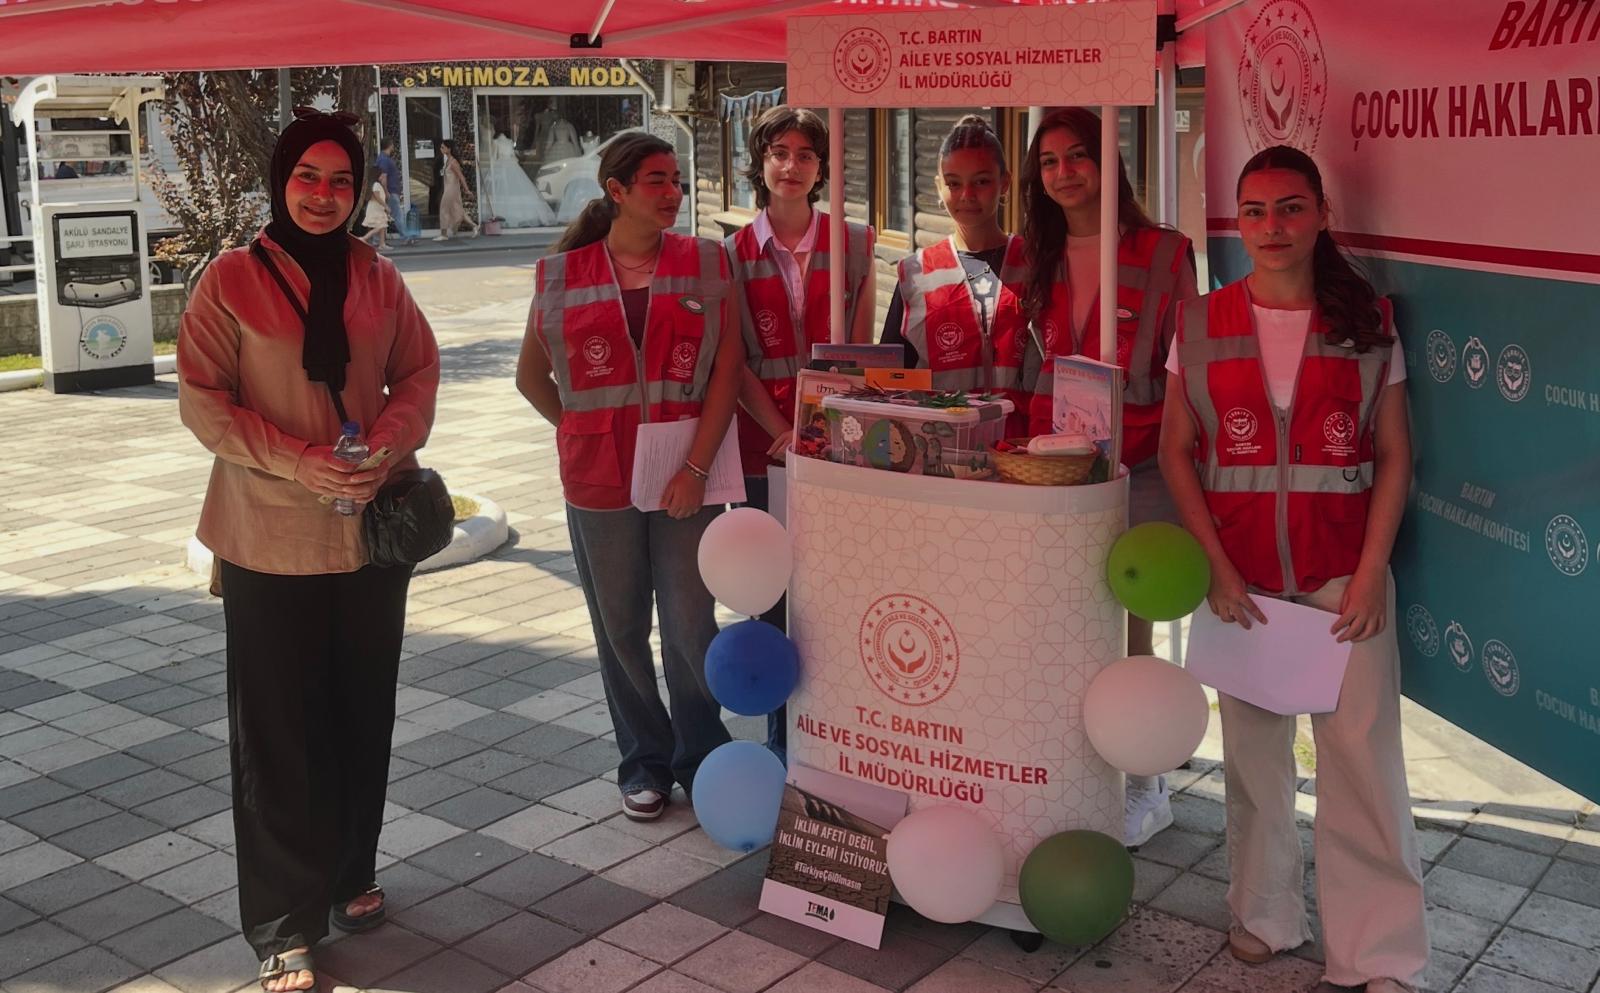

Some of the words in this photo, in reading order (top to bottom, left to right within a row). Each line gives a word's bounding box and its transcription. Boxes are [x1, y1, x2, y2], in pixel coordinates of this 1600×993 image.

[899, 31, 925, 45] T.C.
[928, 29, 982, 44] BARTIN
[899, 50, 933, 67] AİLE
[935, 52, 953, 66] VE
[956, 50, 1012, 66] SOSYAL
[1015, 48, 1102, 65] HİZMETLER
[899, 72, 913, 89] İL
[915, 71, 1012, 89] MÜDÜRLÜĞÜ
[1351, 86, 1440, 152] ÇOCUK
[63, 226, 89, 237] AKÜLÜ
[91, 226, 129, 236] SANDALYE
[1545, 384, 1587, 411] ÇOCUK
[1482, 519, 1531, 553] KOMİTESİ
[855, 705, 887, 729] T.C.
[891, 714, 963, 744] BARTIN
[797, 713, 827, 739] AİLE
[830, 728, 851, 747] VE
[855, 733, 925, 765] SOSYAL
[929, 748, 1048, 785] HİZMETLER
[838, 751, 854, 774] İL
[858, 760, 984, 804] MÜDÜRLÜĞÜ
[794, 815, 820, 837] İKLİM
[820, 822, 848, 845] AFETİ
[778, 829, 804, 850] İKLİM
[805, 839, 839, 861] EYLEMİ
[839, 850, 888, 876] İSTİYORUZ
[807, 901, 829, 917] TEMA
